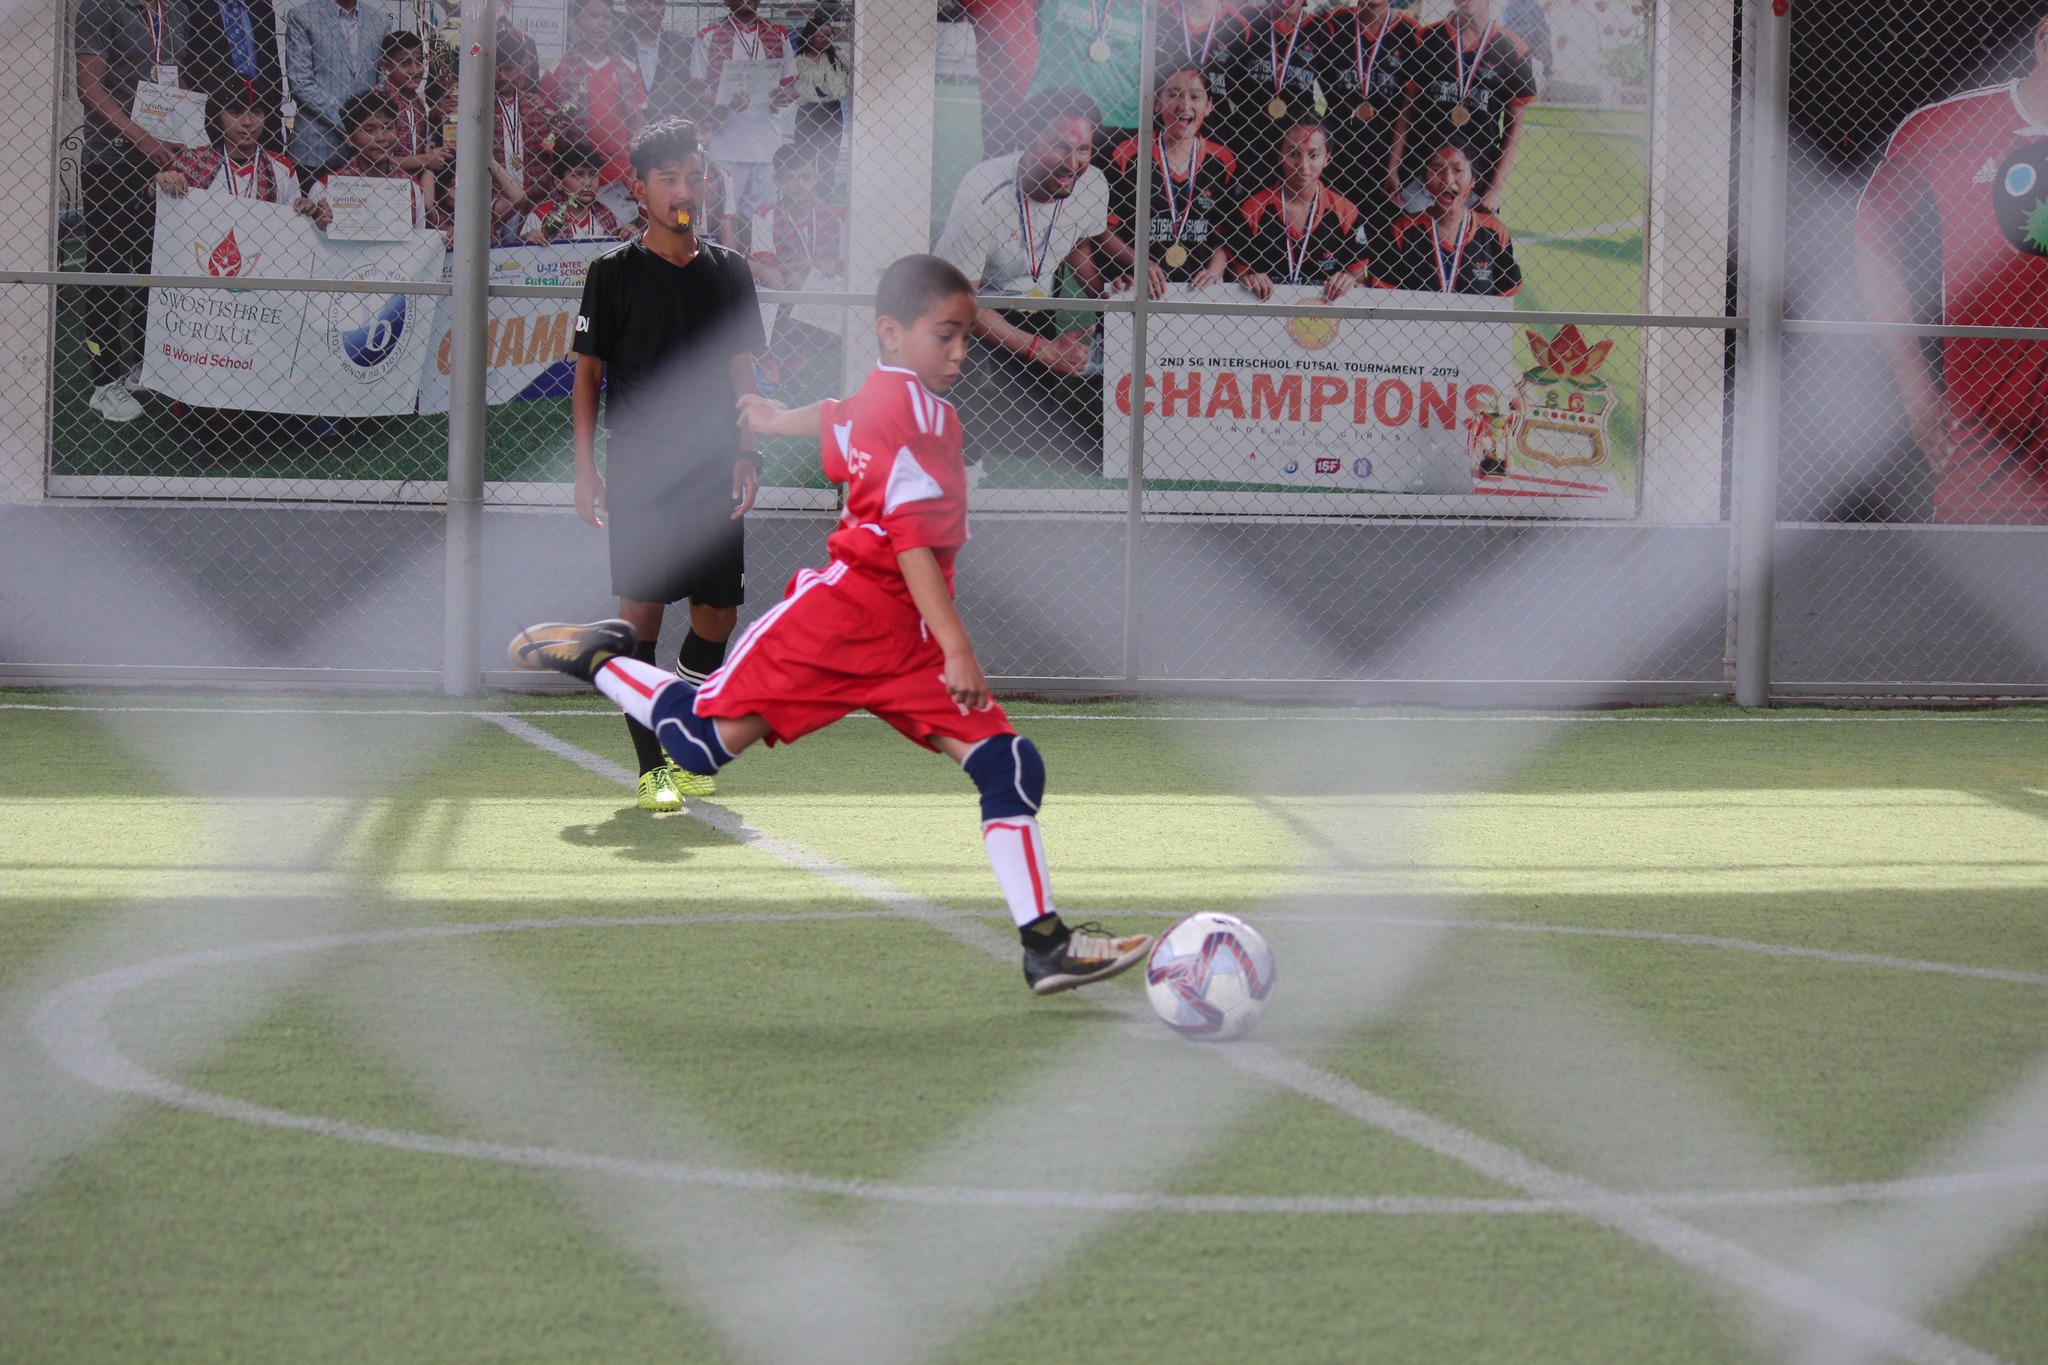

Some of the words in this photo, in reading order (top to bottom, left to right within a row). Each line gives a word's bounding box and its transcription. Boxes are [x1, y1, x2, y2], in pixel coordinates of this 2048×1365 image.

[559, 260, 582, 270] INTER
[559, 267, 588, 276] SCHOO
[159, 286, 283, 325] SWOSTISHREE
[162, 342, 171, 357] IB
[173, 348, 208, 366] World
[210, 353, 254, 370] School
[1160, 357, 1185, 367] 2ND
[1188, 357, 1204, 367] SG
[1208, 357, 1292, 369] INTERSCHOOL
[1296, 360, 1340, 371] FUTSAL
[1344, 362, 1425, 376] TOURNAMENT
[1115, 372, 1498, 431] CHAMPIONS
